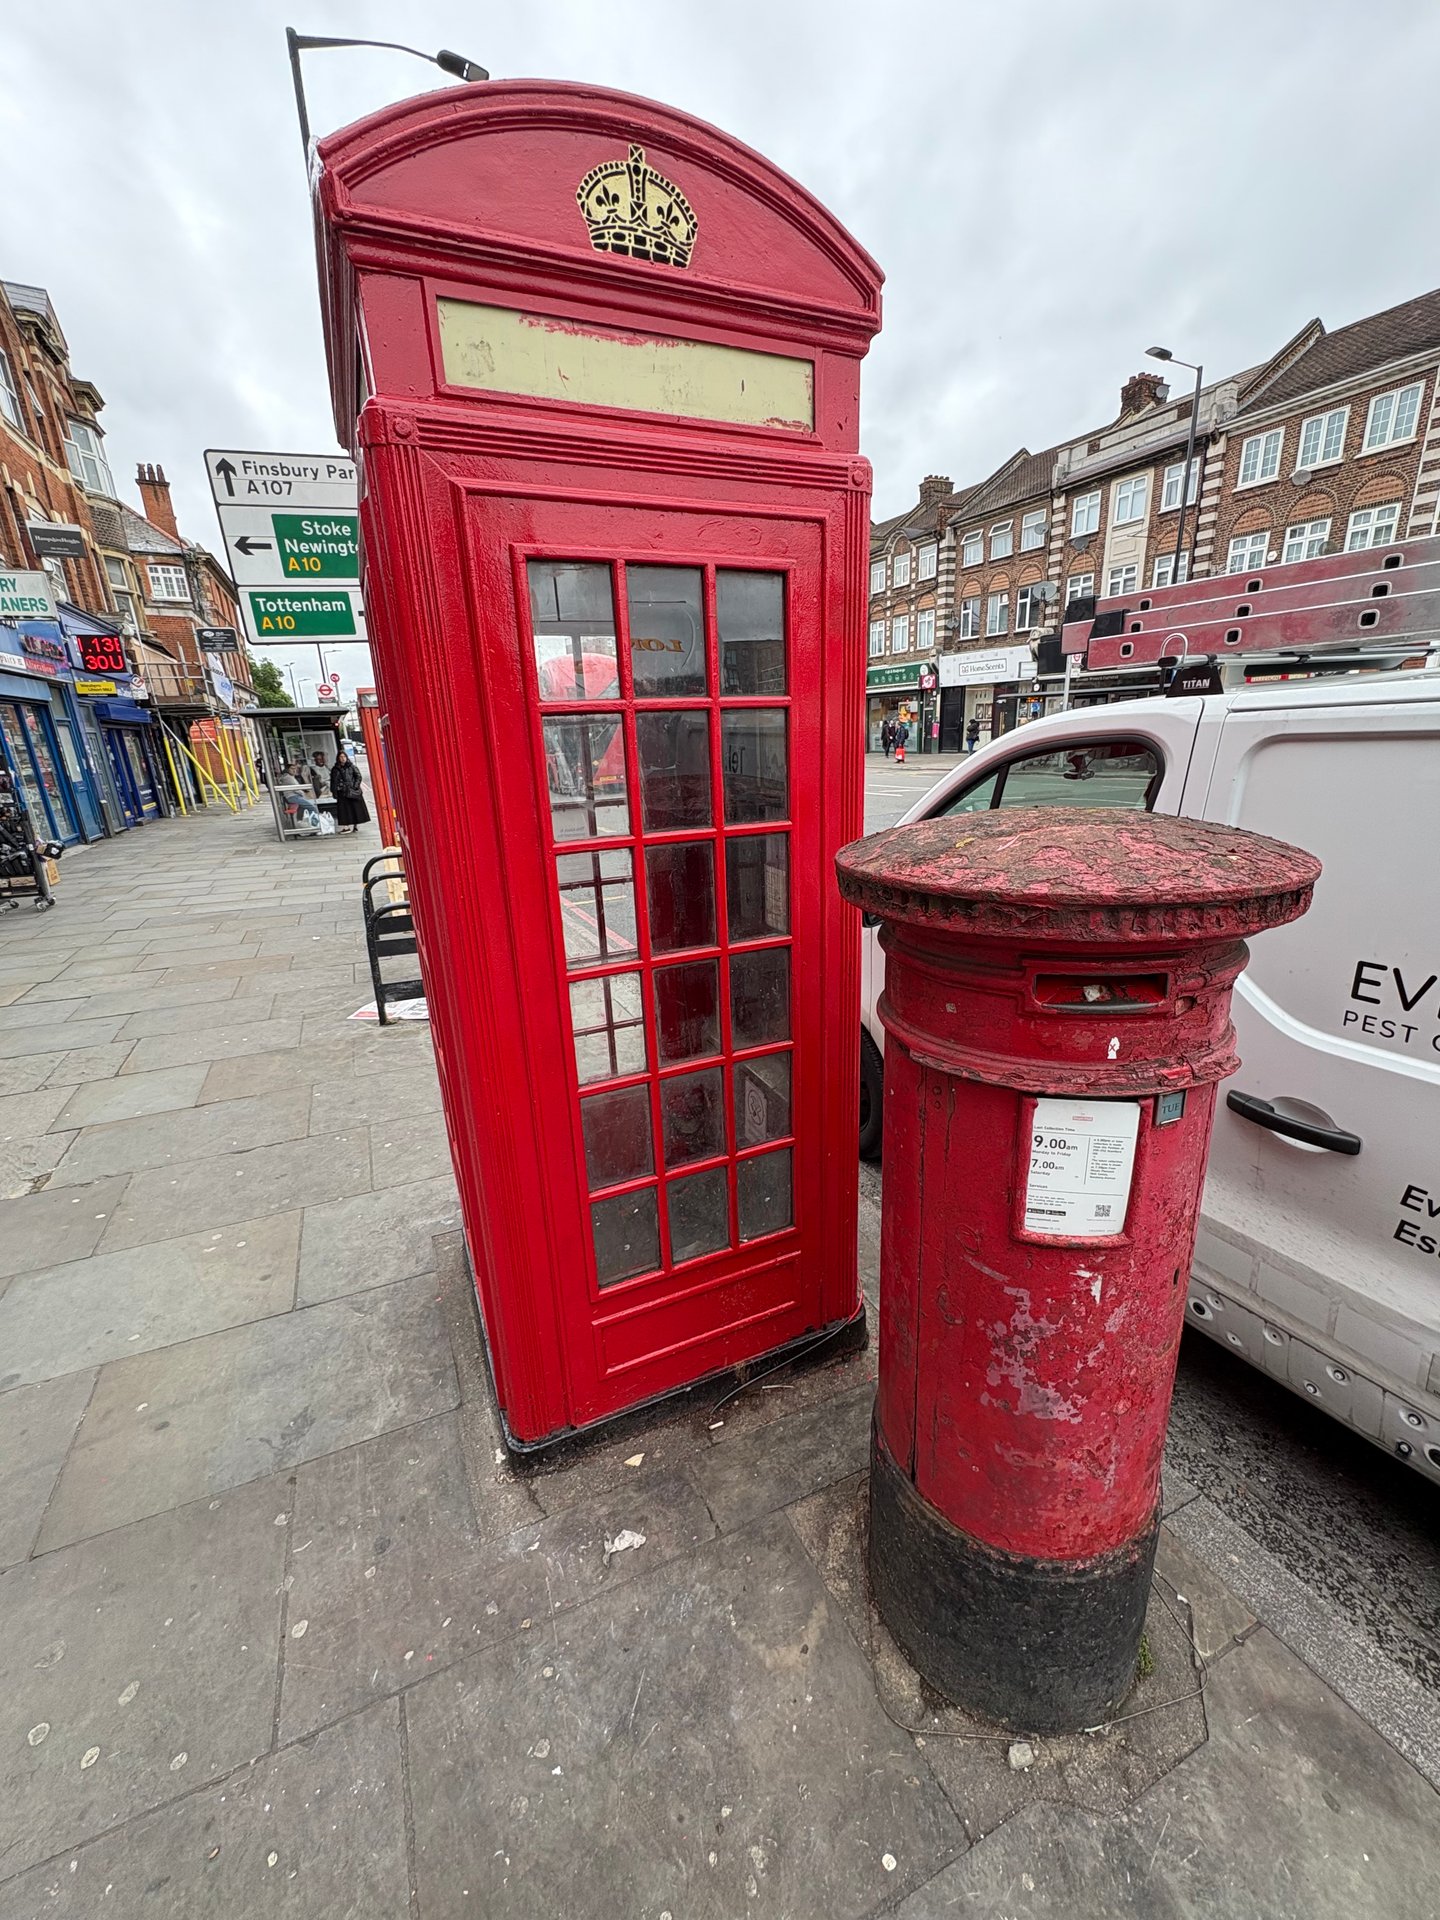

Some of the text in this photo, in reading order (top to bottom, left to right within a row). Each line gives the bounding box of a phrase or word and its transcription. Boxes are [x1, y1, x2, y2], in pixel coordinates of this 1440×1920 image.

[242, 460, 356, 480] Finsbury Par
[247, 480, 293, 496] A107
[301, 520, 351, 536] Stoke
[284, 538, 360, 556] Newingt
[288, 557, 321, 572] A10
[0, 578, 17, 592] RY
[0, 597, 49, 612] ANERS
[255, 597, 346, 612] Tottenham
[261, 616, 296, 630] A10
[1182, 678, 1211, 689] TITAN
[1351, 960, 1440, 1019] EV
[1342, 1010, 1419, 1043] PEST
[1161, 1103, 1181, 1114] TUE
[1033, 1135, 1078, 1151] 9.00am
[1031, 1159, 1065, 1171] 7.00am
[1393, 1219, 1440, 1259] Es
